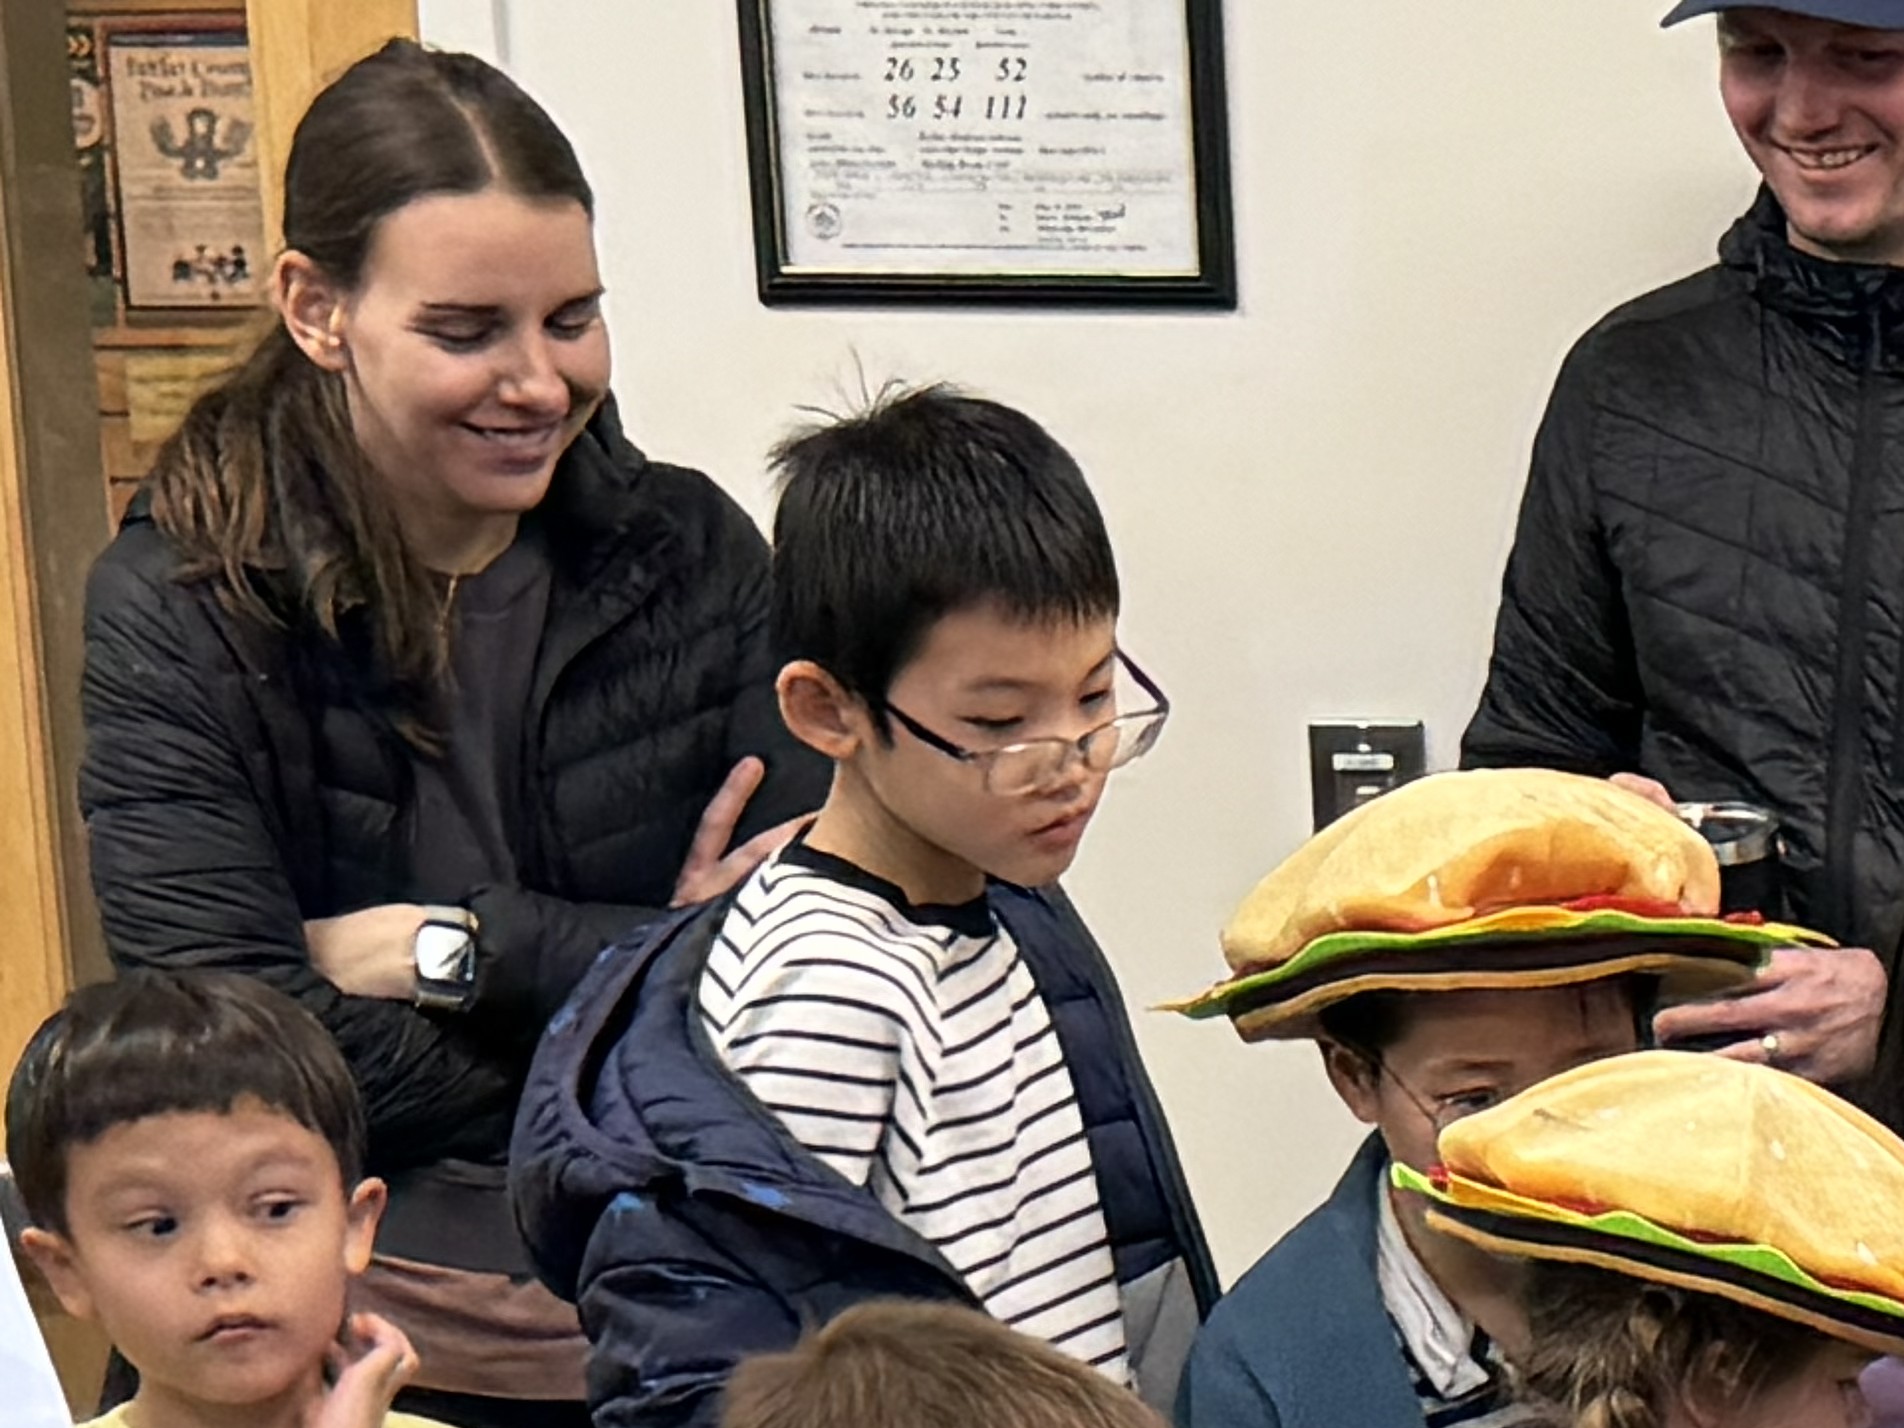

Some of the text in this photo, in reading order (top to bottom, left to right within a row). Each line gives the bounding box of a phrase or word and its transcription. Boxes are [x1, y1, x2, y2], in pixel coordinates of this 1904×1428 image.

[884, 57, 914, 82] 26
[930, 57, 961, 82] 25
[996, 57, 1027, 82] 52
[886, 93, 916, 120] 56
